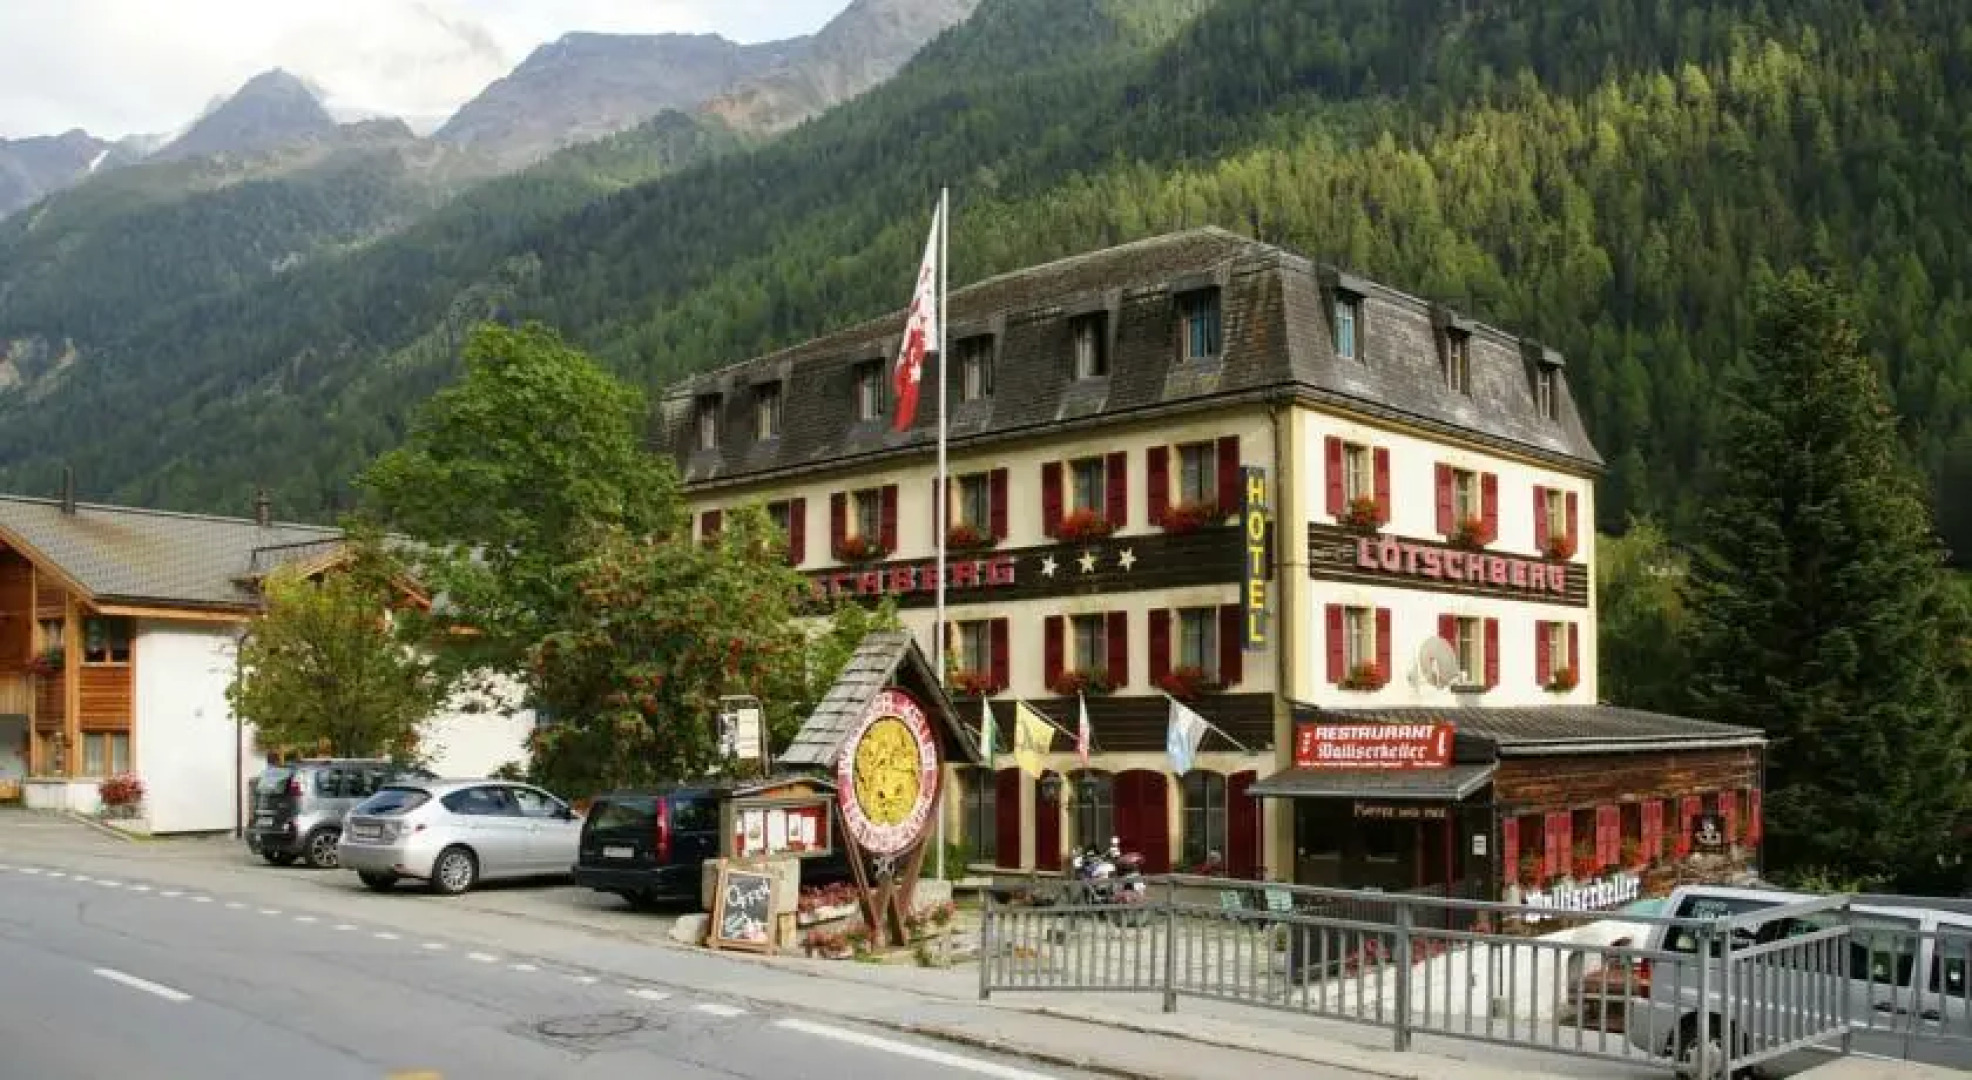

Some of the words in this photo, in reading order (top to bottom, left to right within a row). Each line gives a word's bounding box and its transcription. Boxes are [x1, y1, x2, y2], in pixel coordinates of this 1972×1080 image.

[1248, 475, 1265, 642] HOTEL
[1357, 534, 1567, 592] LÖTSCHBERG
[1315, 725, 1434, 740] RESTAURANT
